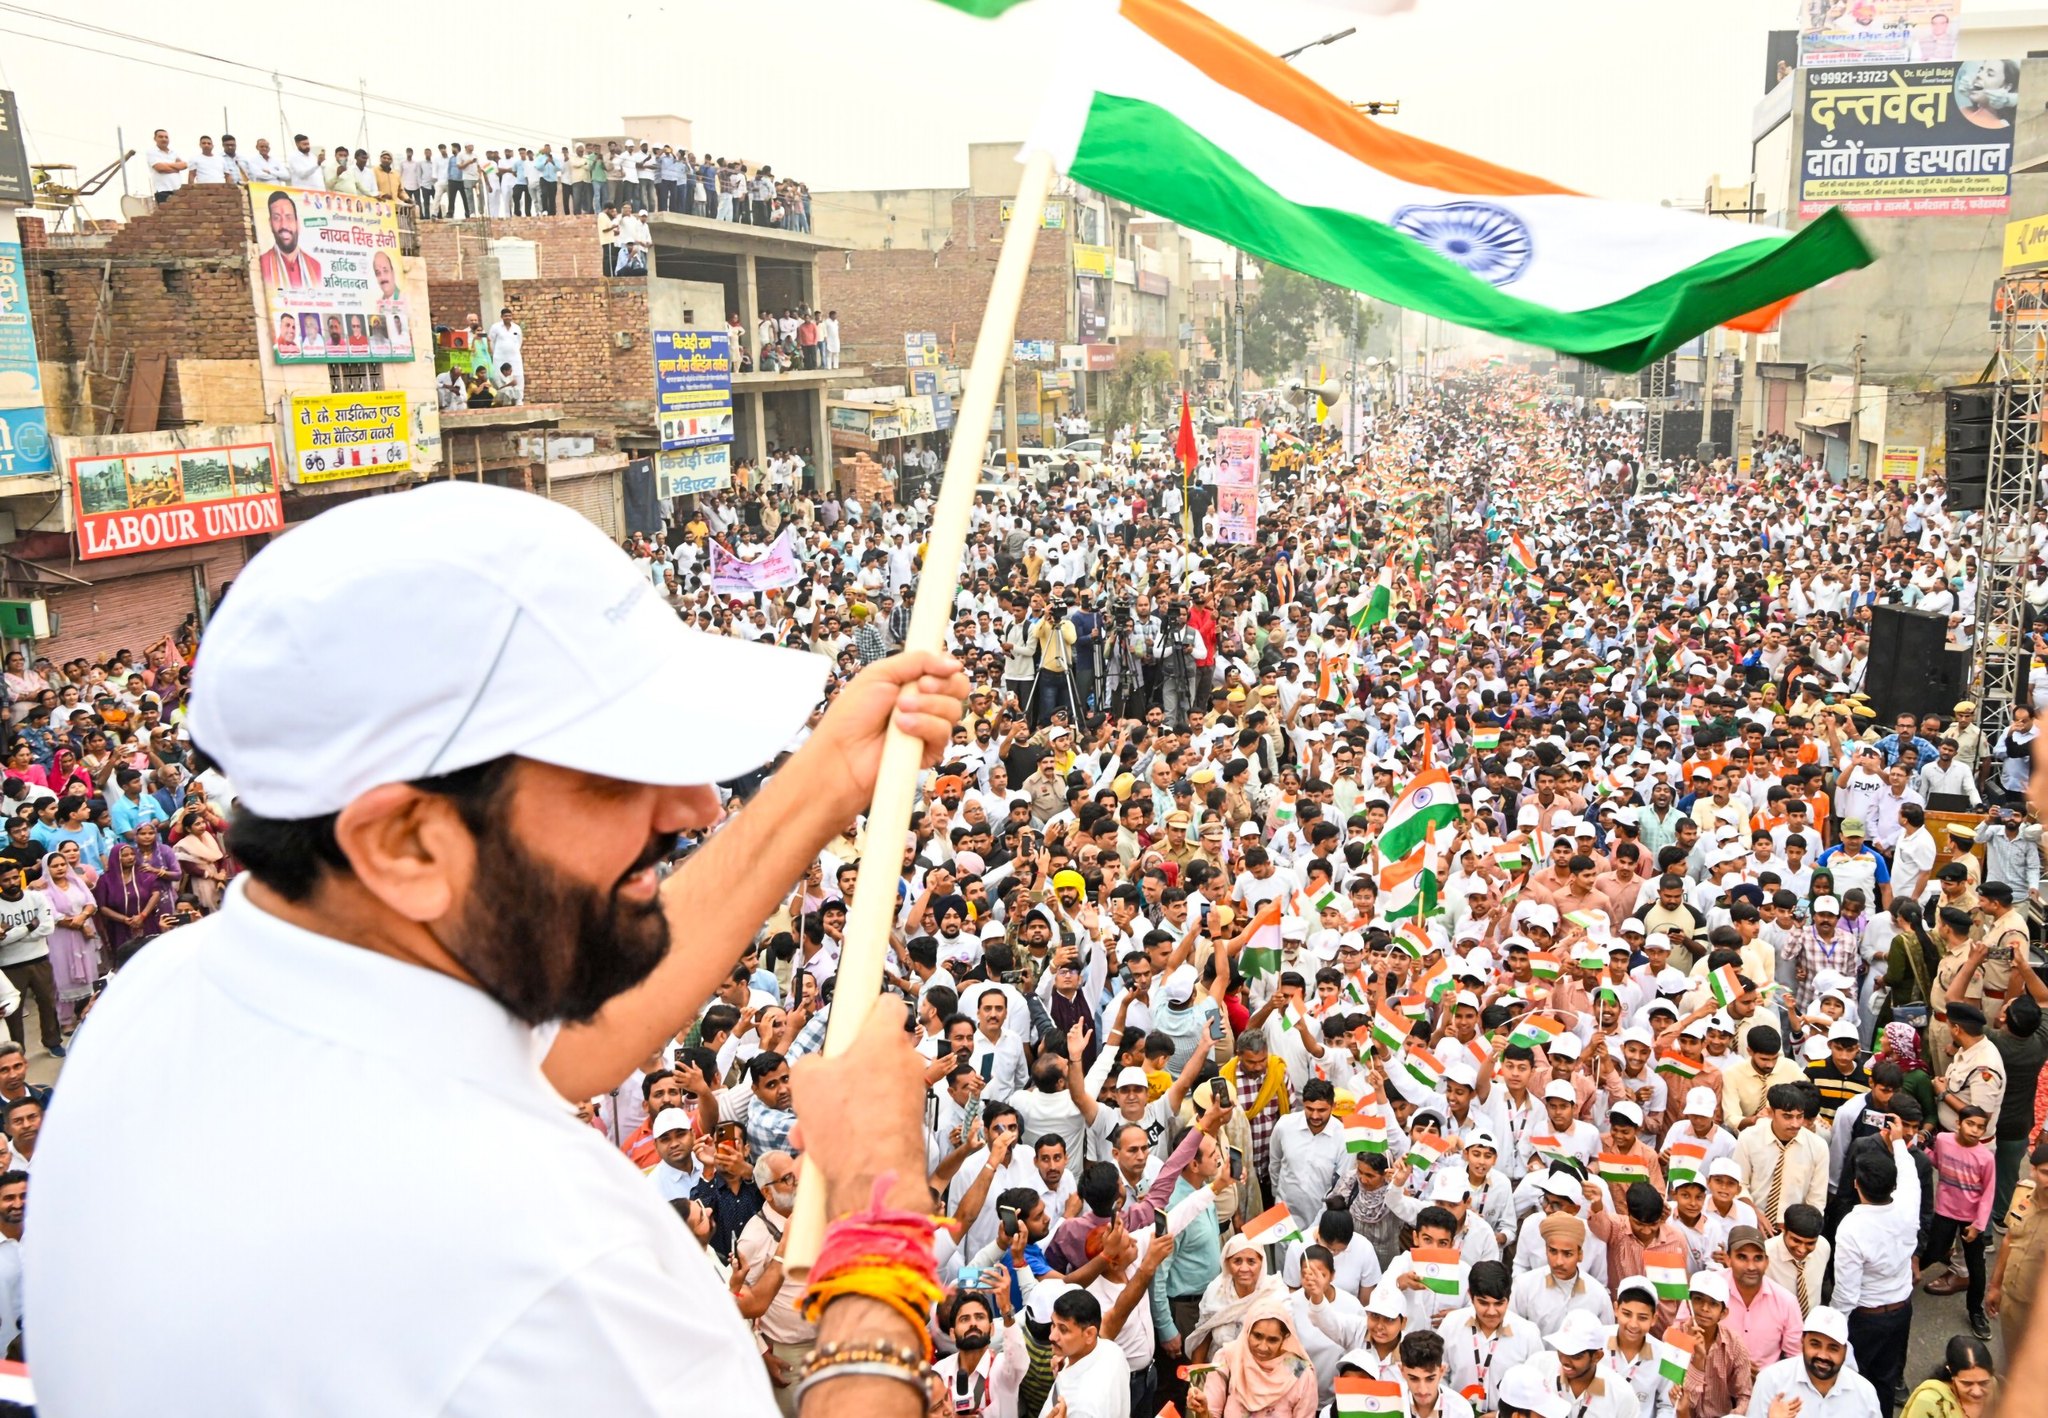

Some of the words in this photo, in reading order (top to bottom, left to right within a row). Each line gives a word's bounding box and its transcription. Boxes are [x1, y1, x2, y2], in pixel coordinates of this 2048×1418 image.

[1820, 70, 1888, 84] 99921-33723
[1904, 70, 1915, 78] Dr.
[1810, 69, 1952, 132] दन्तवेदा
[1806, 135, 1864, 177] दाँतों
[1863, 147, 1900, 175] का
[1903, 142, 2010, 174] हस्पताल
[351, 225, 374, 248] सिंह
[375, 228, 397, 248] सैनी
[330, 257, 357, 273] हार्दिक
[323, 274, 368, 290] अभिनन्दन
[312, 429, 332, 446] गैस
[660, 449, 702, 472] किरोड़ी
[704, 450, 726, 466] राम
[672, 475, 718, 494] रेडिएटर
[84, 509, 200, 554] LABOUR
[205, 497, 279, 537] UNION
